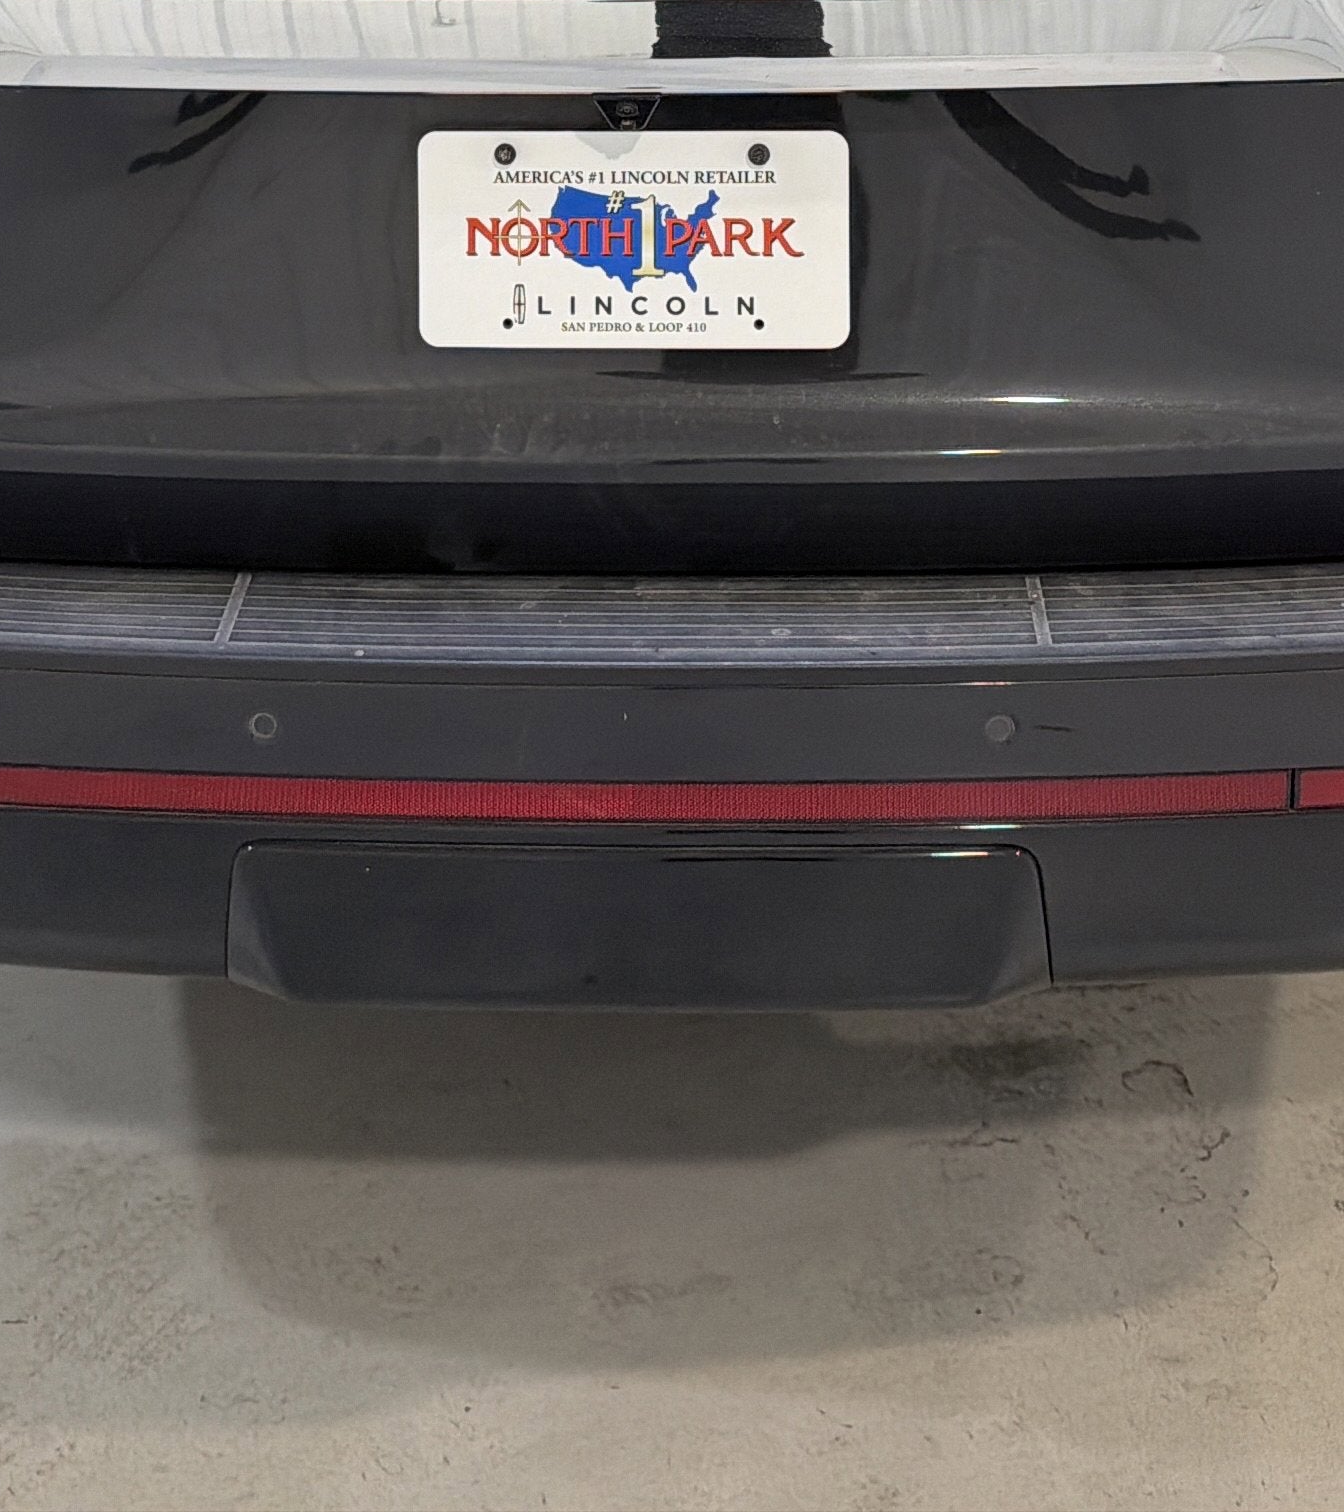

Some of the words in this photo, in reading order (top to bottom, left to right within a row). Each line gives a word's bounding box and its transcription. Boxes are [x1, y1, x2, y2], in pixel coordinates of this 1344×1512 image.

[493, 170, 584, 185] AMERICA'S
[587, 170, 605, 184] #1
[610, 170, 690, 184] LINCOLN
[694, 170, 777, 185] RETAILER
[466, 217, 635, 257] NORTH
[663, 217, 805, 257] PARK
[537, 295, 755, 316] LINCOLN
[561, 321, 586, 333] SAN
[589, 321, 632, 333] PEDRO
[635, 321, 647, 333] &
[648, 321, 683, 333] LOOP
[686, 321, 707, 333] 410
